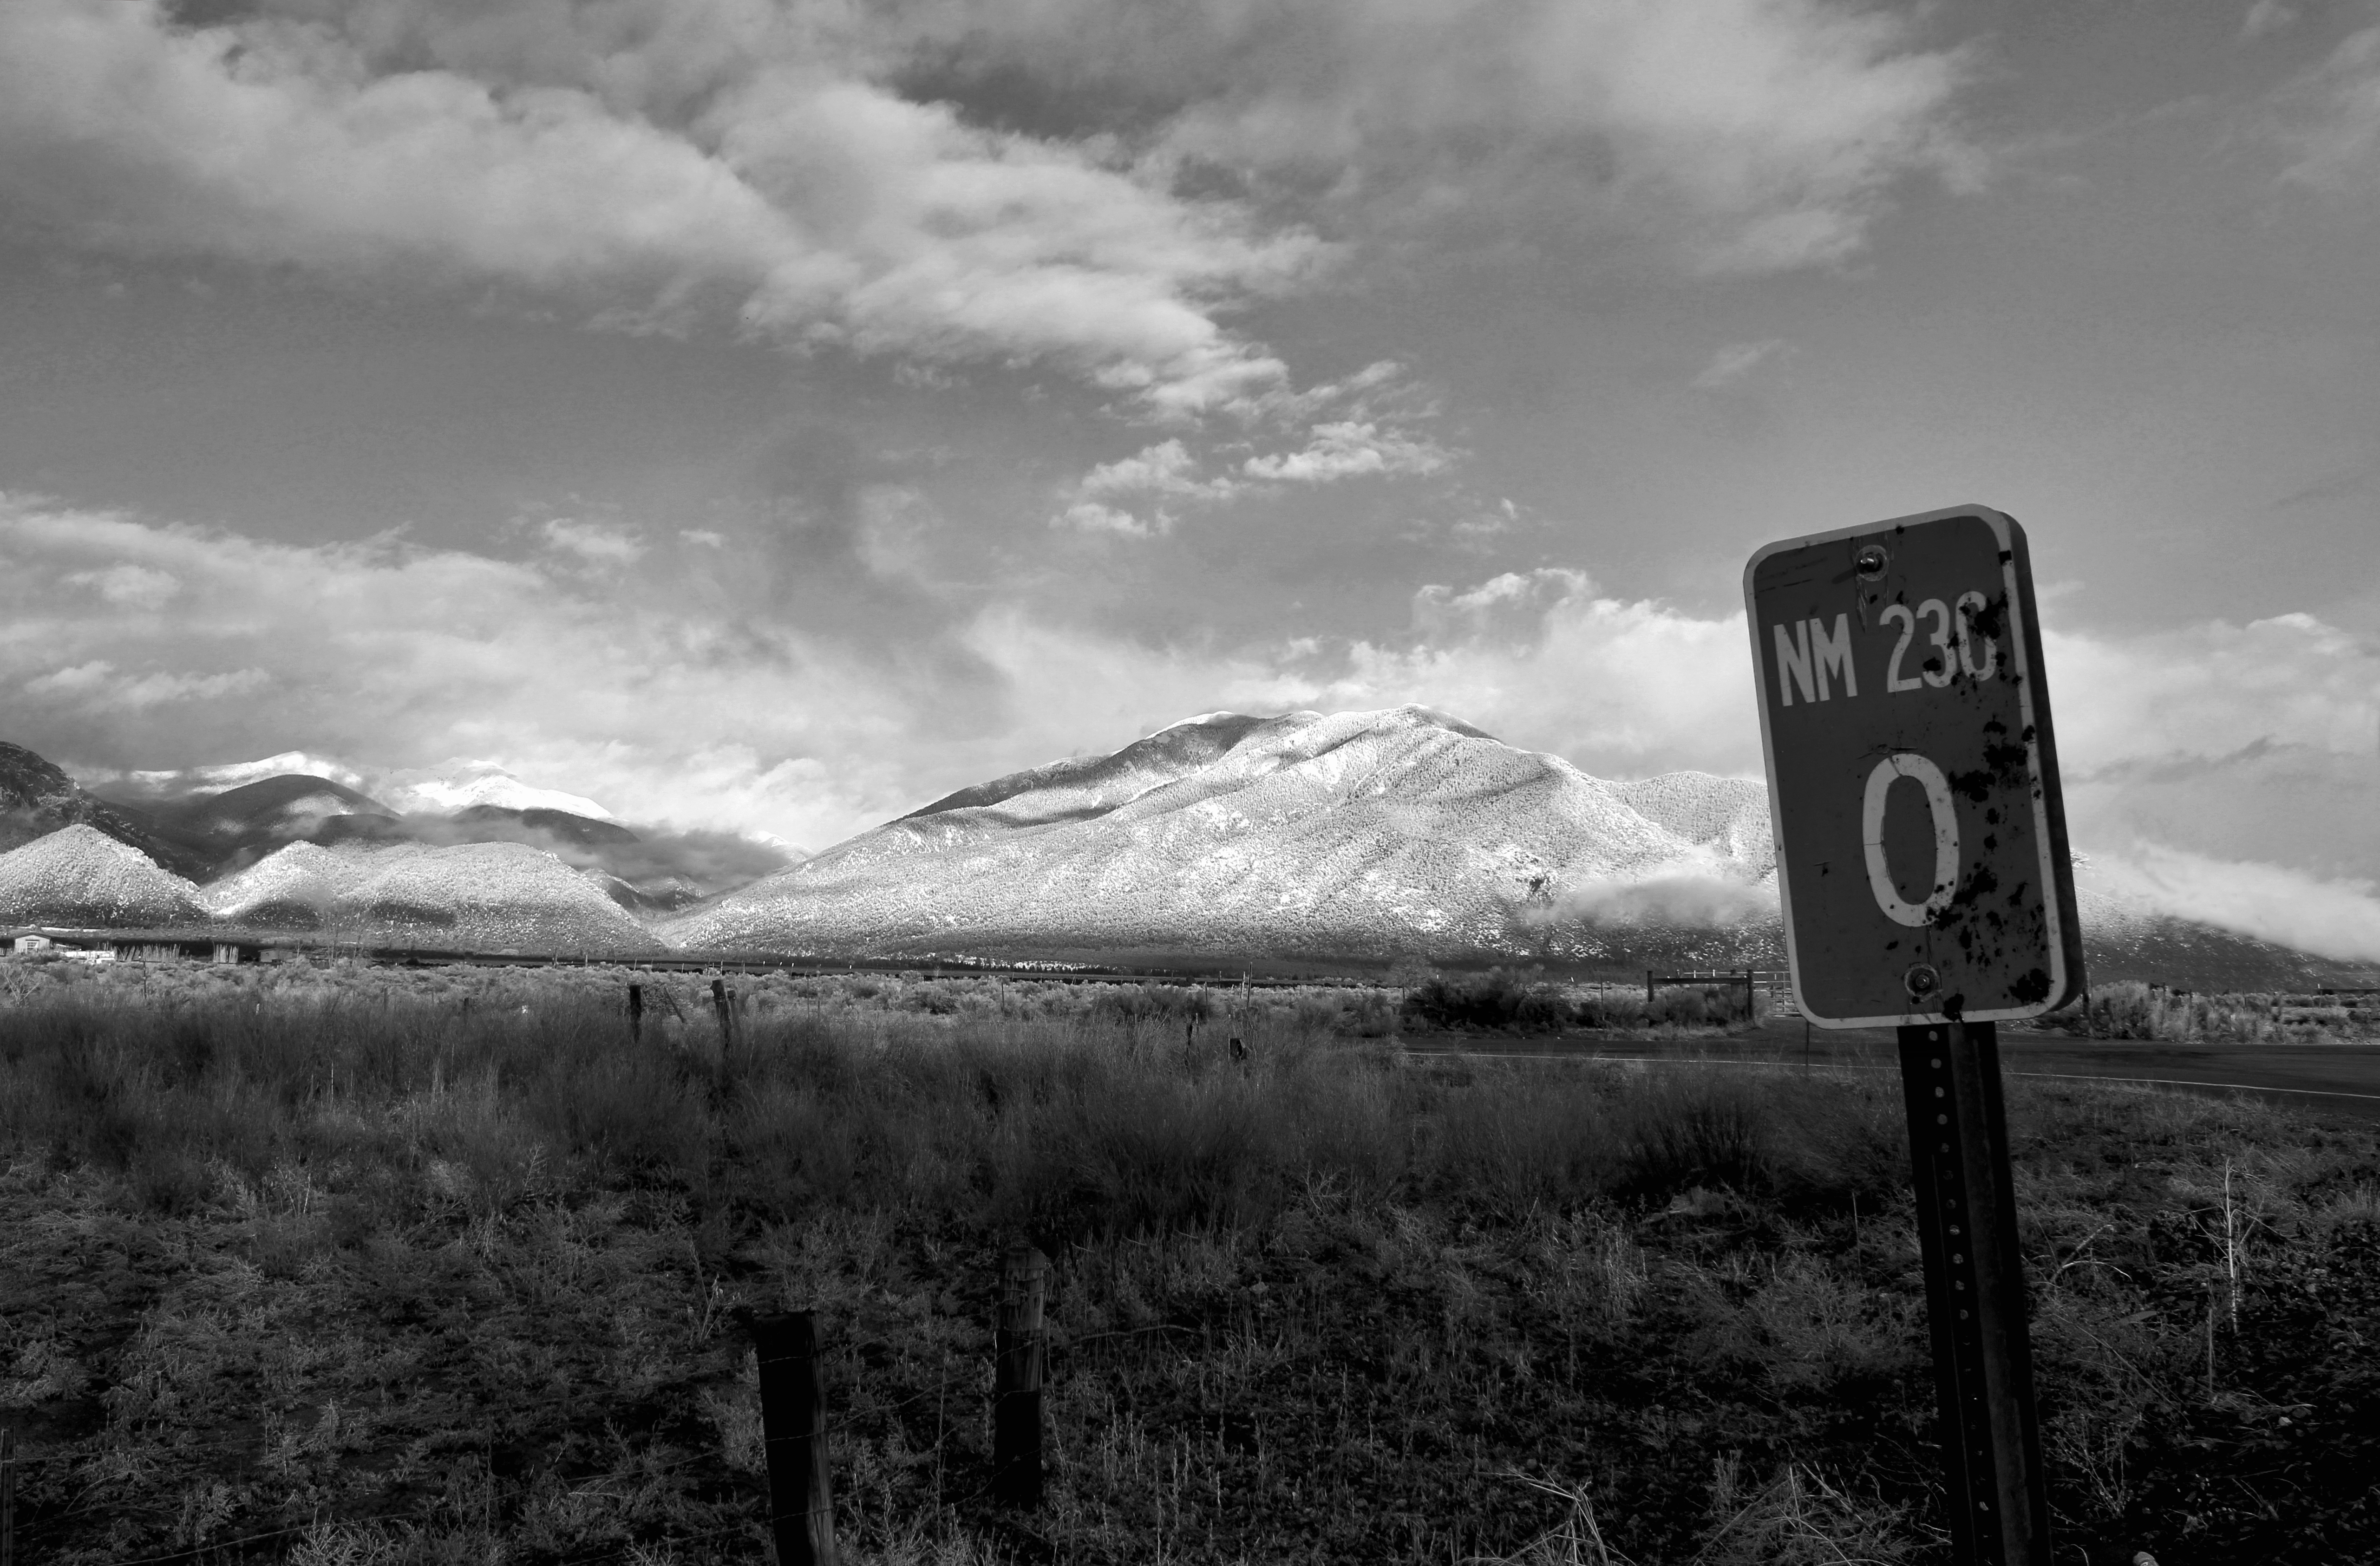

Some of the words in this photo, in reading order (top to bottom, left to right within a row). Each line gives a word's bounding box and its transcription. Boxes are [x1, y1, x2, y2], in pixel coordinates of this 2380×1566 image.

[1774, 613, 1857, 706] NM
[1879, 591, 1997, 692] 230
[1863, 753, 1960, 927] 0
